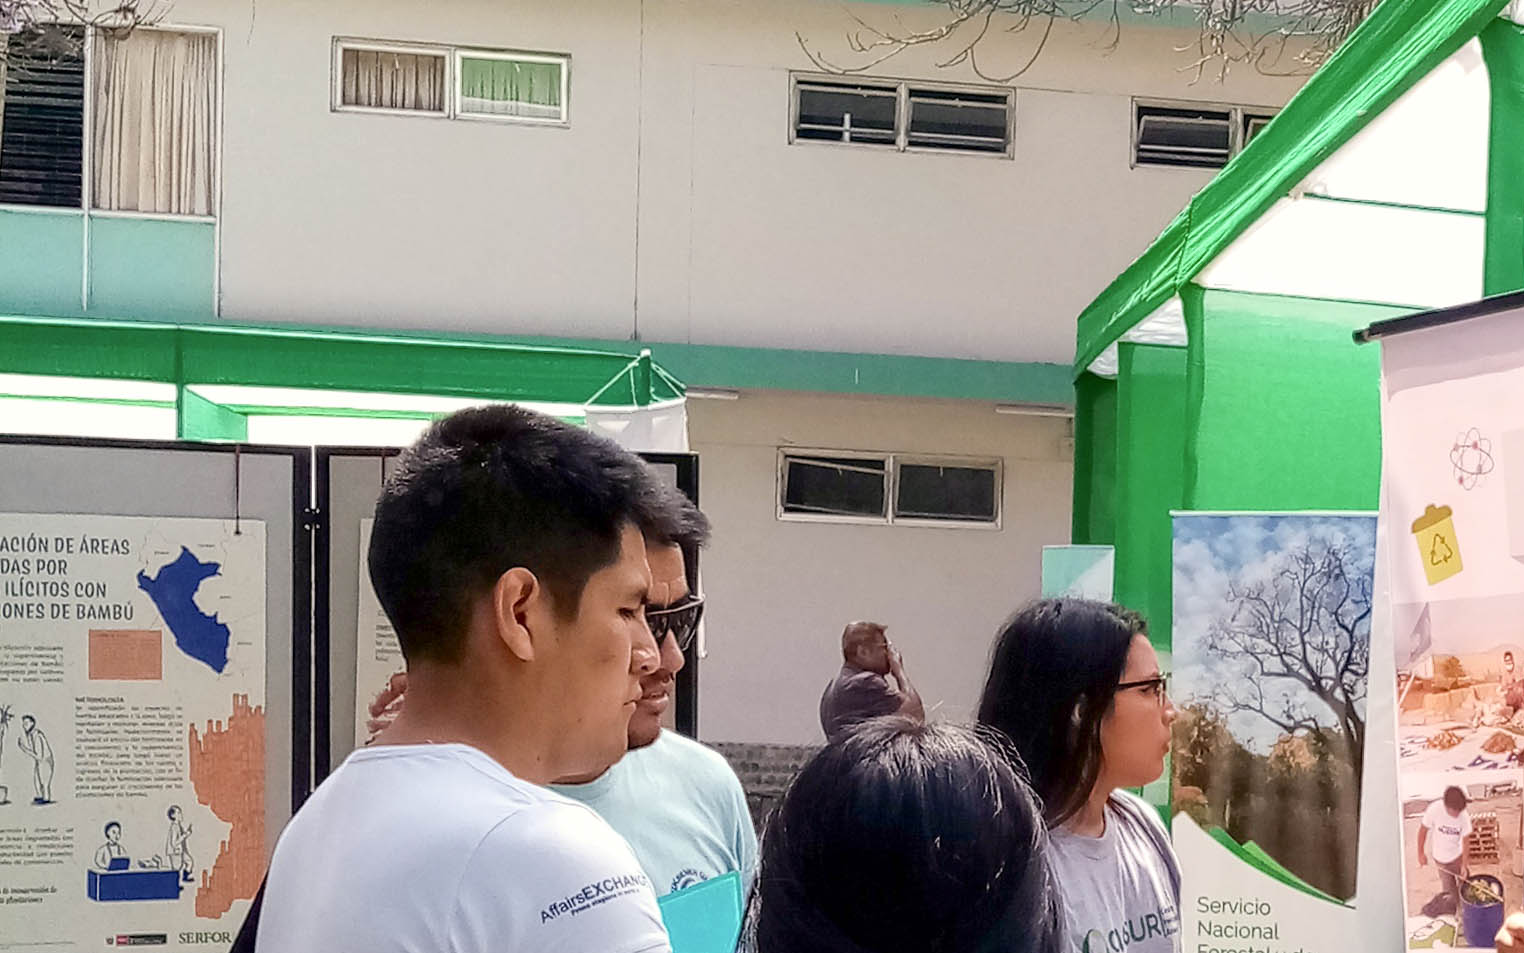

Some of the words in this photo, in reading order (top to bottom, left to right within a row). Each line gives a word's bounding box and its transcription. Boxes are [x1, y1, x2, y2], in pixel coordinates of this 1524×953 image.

[0, 532, 49, 553] ACIÓN
[55, 537, 74, 554] DE
[80, 534, 130, 555] ÁREAS
[0, 559, 31, 575] DAS
[36, 559, 67, 576] POR
[5, 577, 70, 598] ILÍCITOS
[75, 582, 106, 598] CON
[2, 602, 45, 620] ONES
[50, 603, 70, 620] DE
[76, 602, 133, 621] BAMBÚ
[1197, 897, 1272, 917] Servicio
[179, 932, 232, 944] SERFOR
[1197, 920, 1280, 941] Nacional
